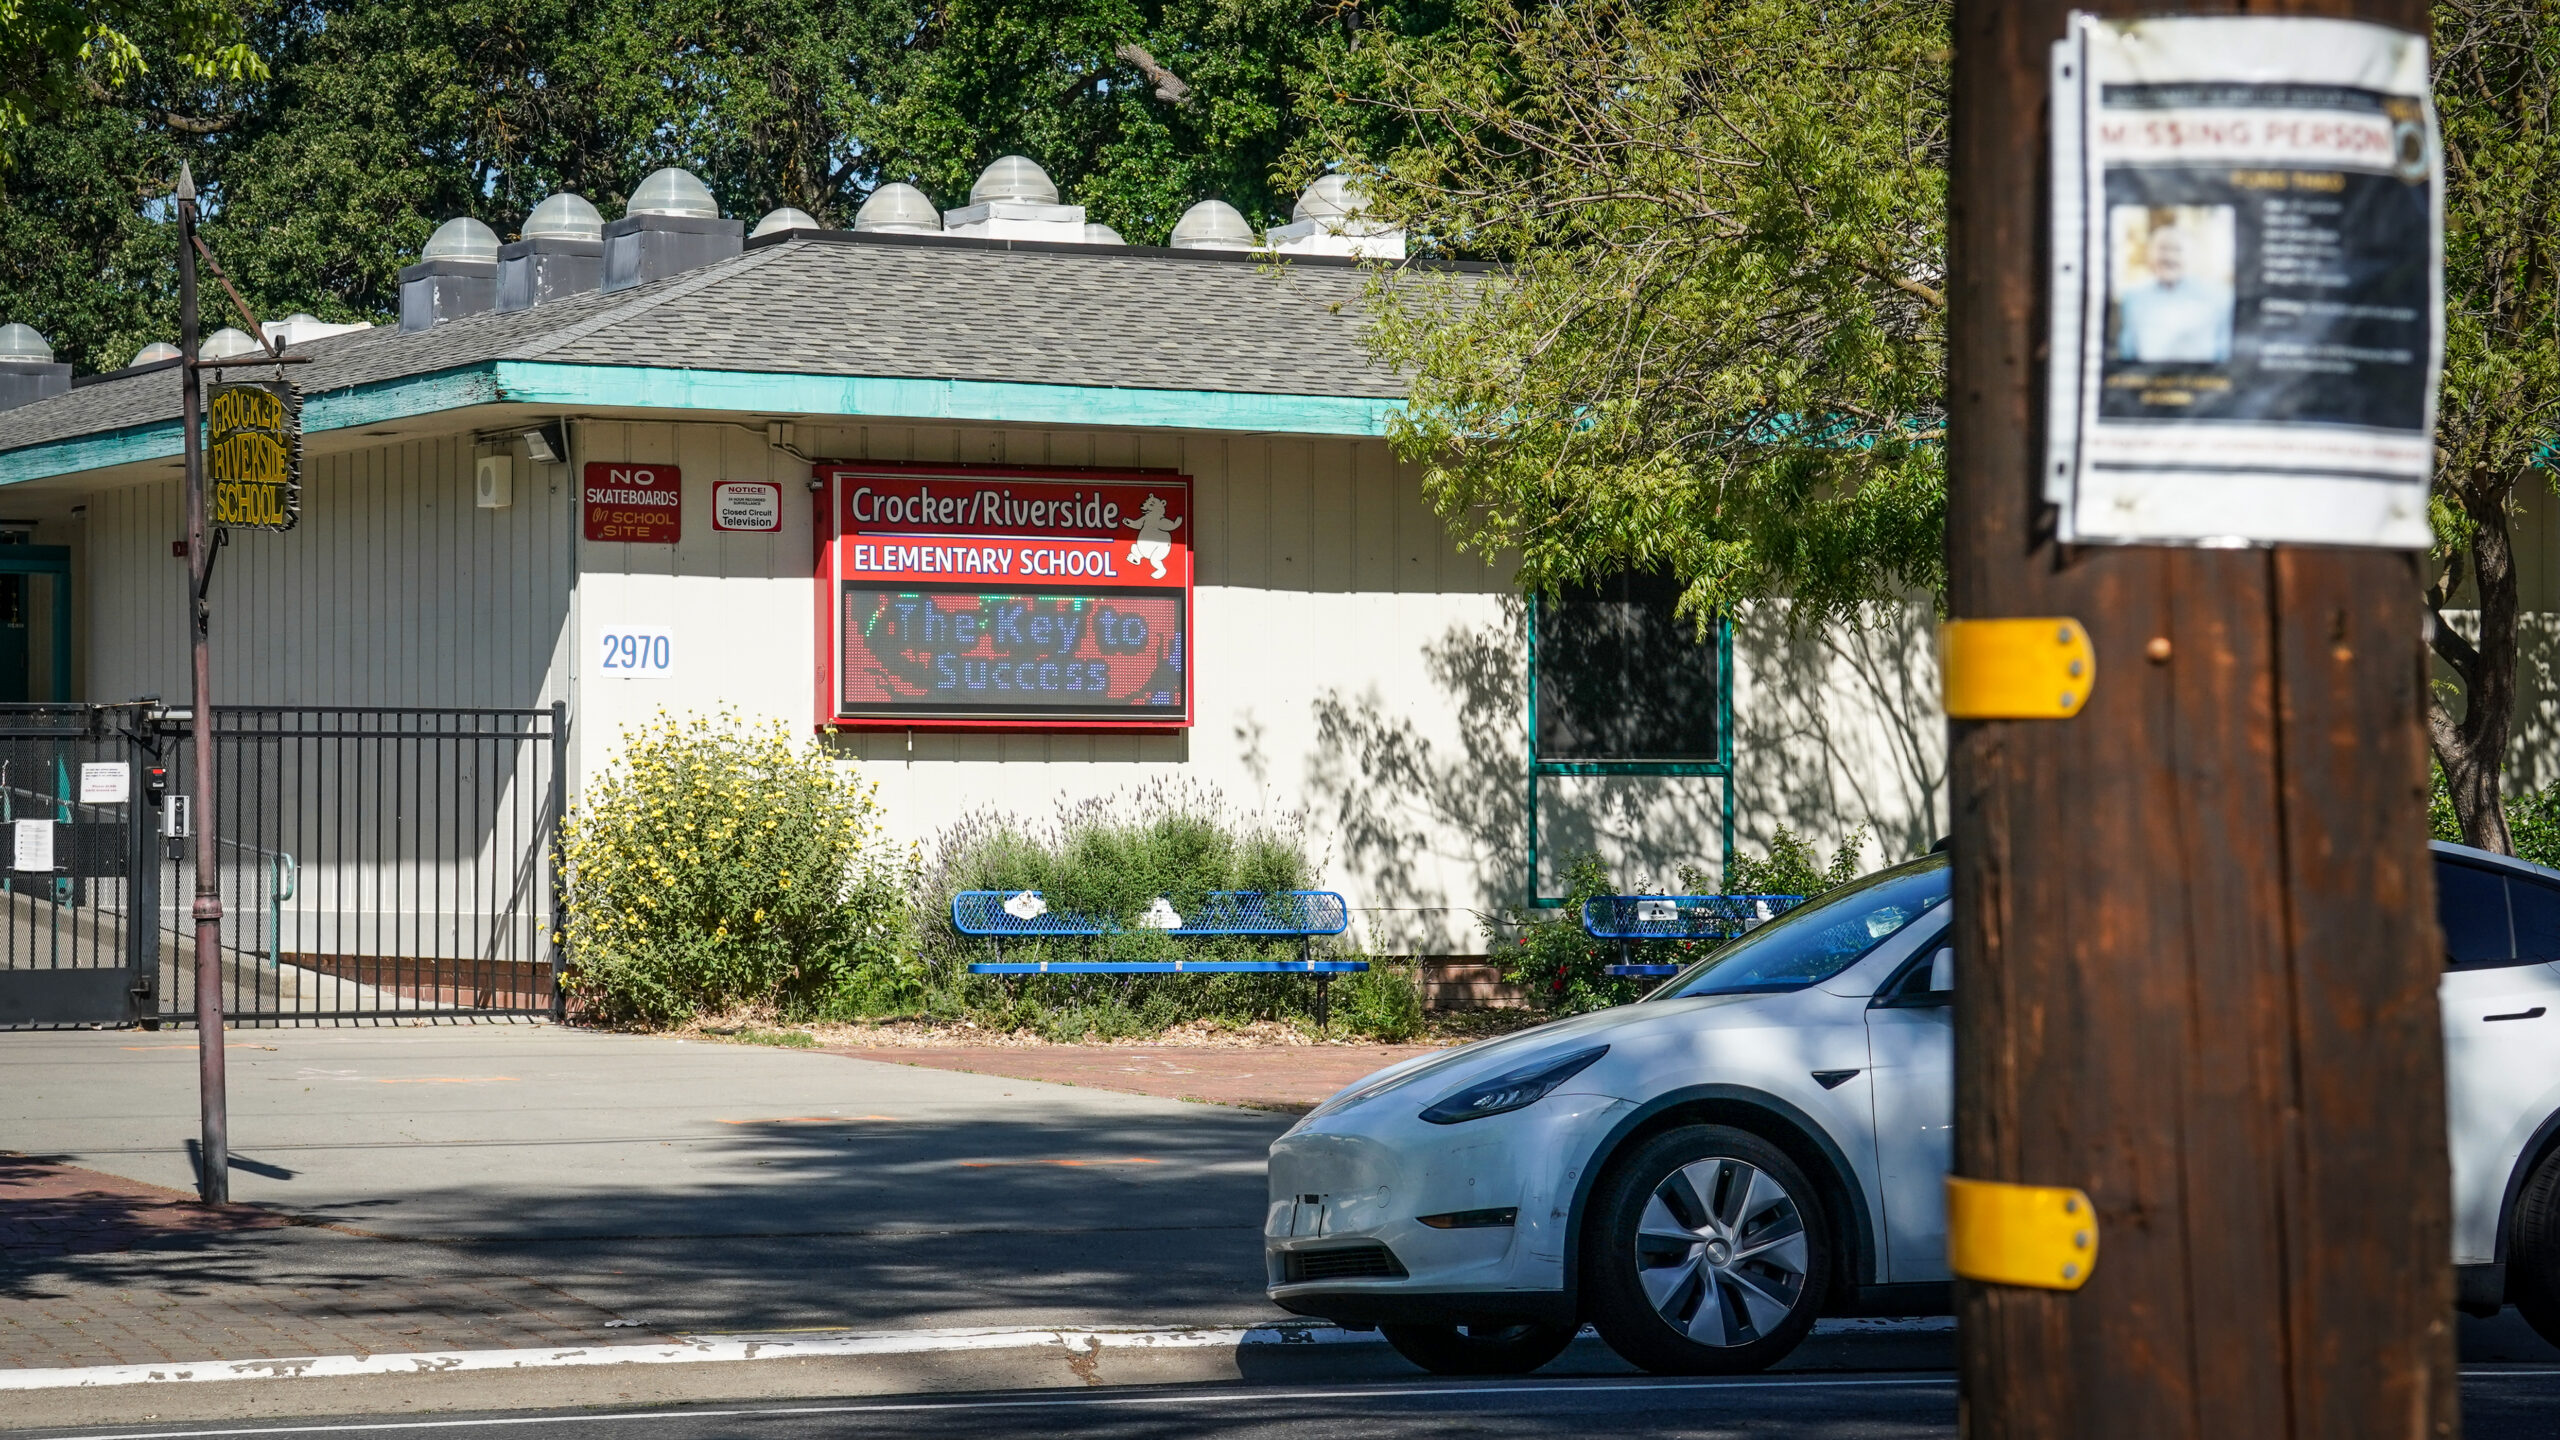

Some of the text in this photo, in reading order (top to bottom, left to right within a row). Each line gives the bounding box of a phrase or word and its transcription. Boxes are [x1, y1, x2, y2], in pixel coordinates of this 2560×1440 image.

[2100, 121, 2392, 151] MSSING PERSON
[212, 389, 283, 444] CROCKER
[213, 432, 288, 484] RIVERSIDE
[610, 469, 655, 486] NO
[728, 486, 766, 494] NOTICE!
[217, 483, 283, 525] SCHOOL
[586, 488, 678, 506] SKATEBOARDS
[722, 508, 747, 516] Closed
[852, 486, 1119, 530] Crocker/Riverside
[603, 525, 650, 537] SITE
[612, 511, 674, 525] SCHOOL
[722, 516, 772, 527] Television
[854, 544, 1118, 578] ELEMENTARY SCHOOL
[895, 601, 1148, 655] The Key to
[602, 634, 670, 669] 2970
[936, 651, 1107, 692] Success
